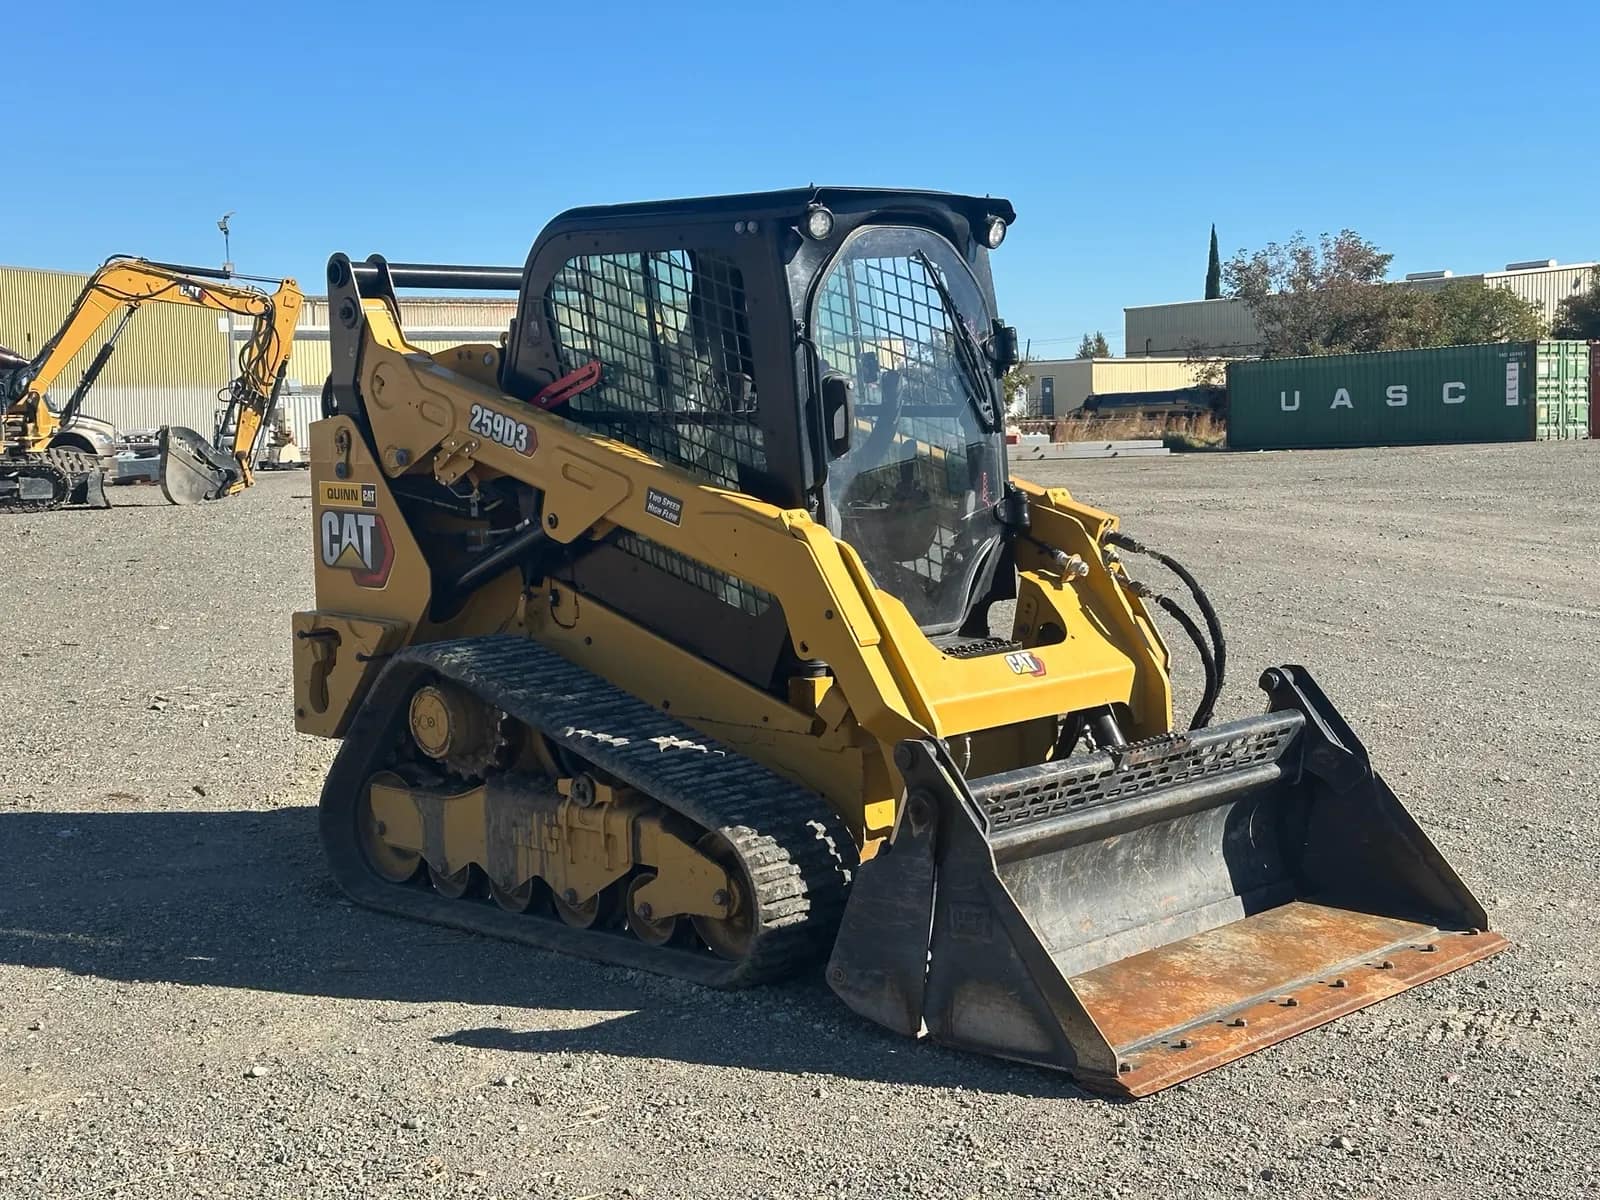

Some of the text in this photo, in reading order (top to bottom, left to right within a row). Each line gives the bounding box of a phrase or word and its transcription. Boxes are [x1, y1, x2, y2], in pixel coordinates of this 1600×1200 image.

[469, 404, 528, 452] 259D3
[327, 488, 375, 502] QUINN CAT
[321, 511, 376, 569] CAT
[1004, 652, 1039, 675] CAT
